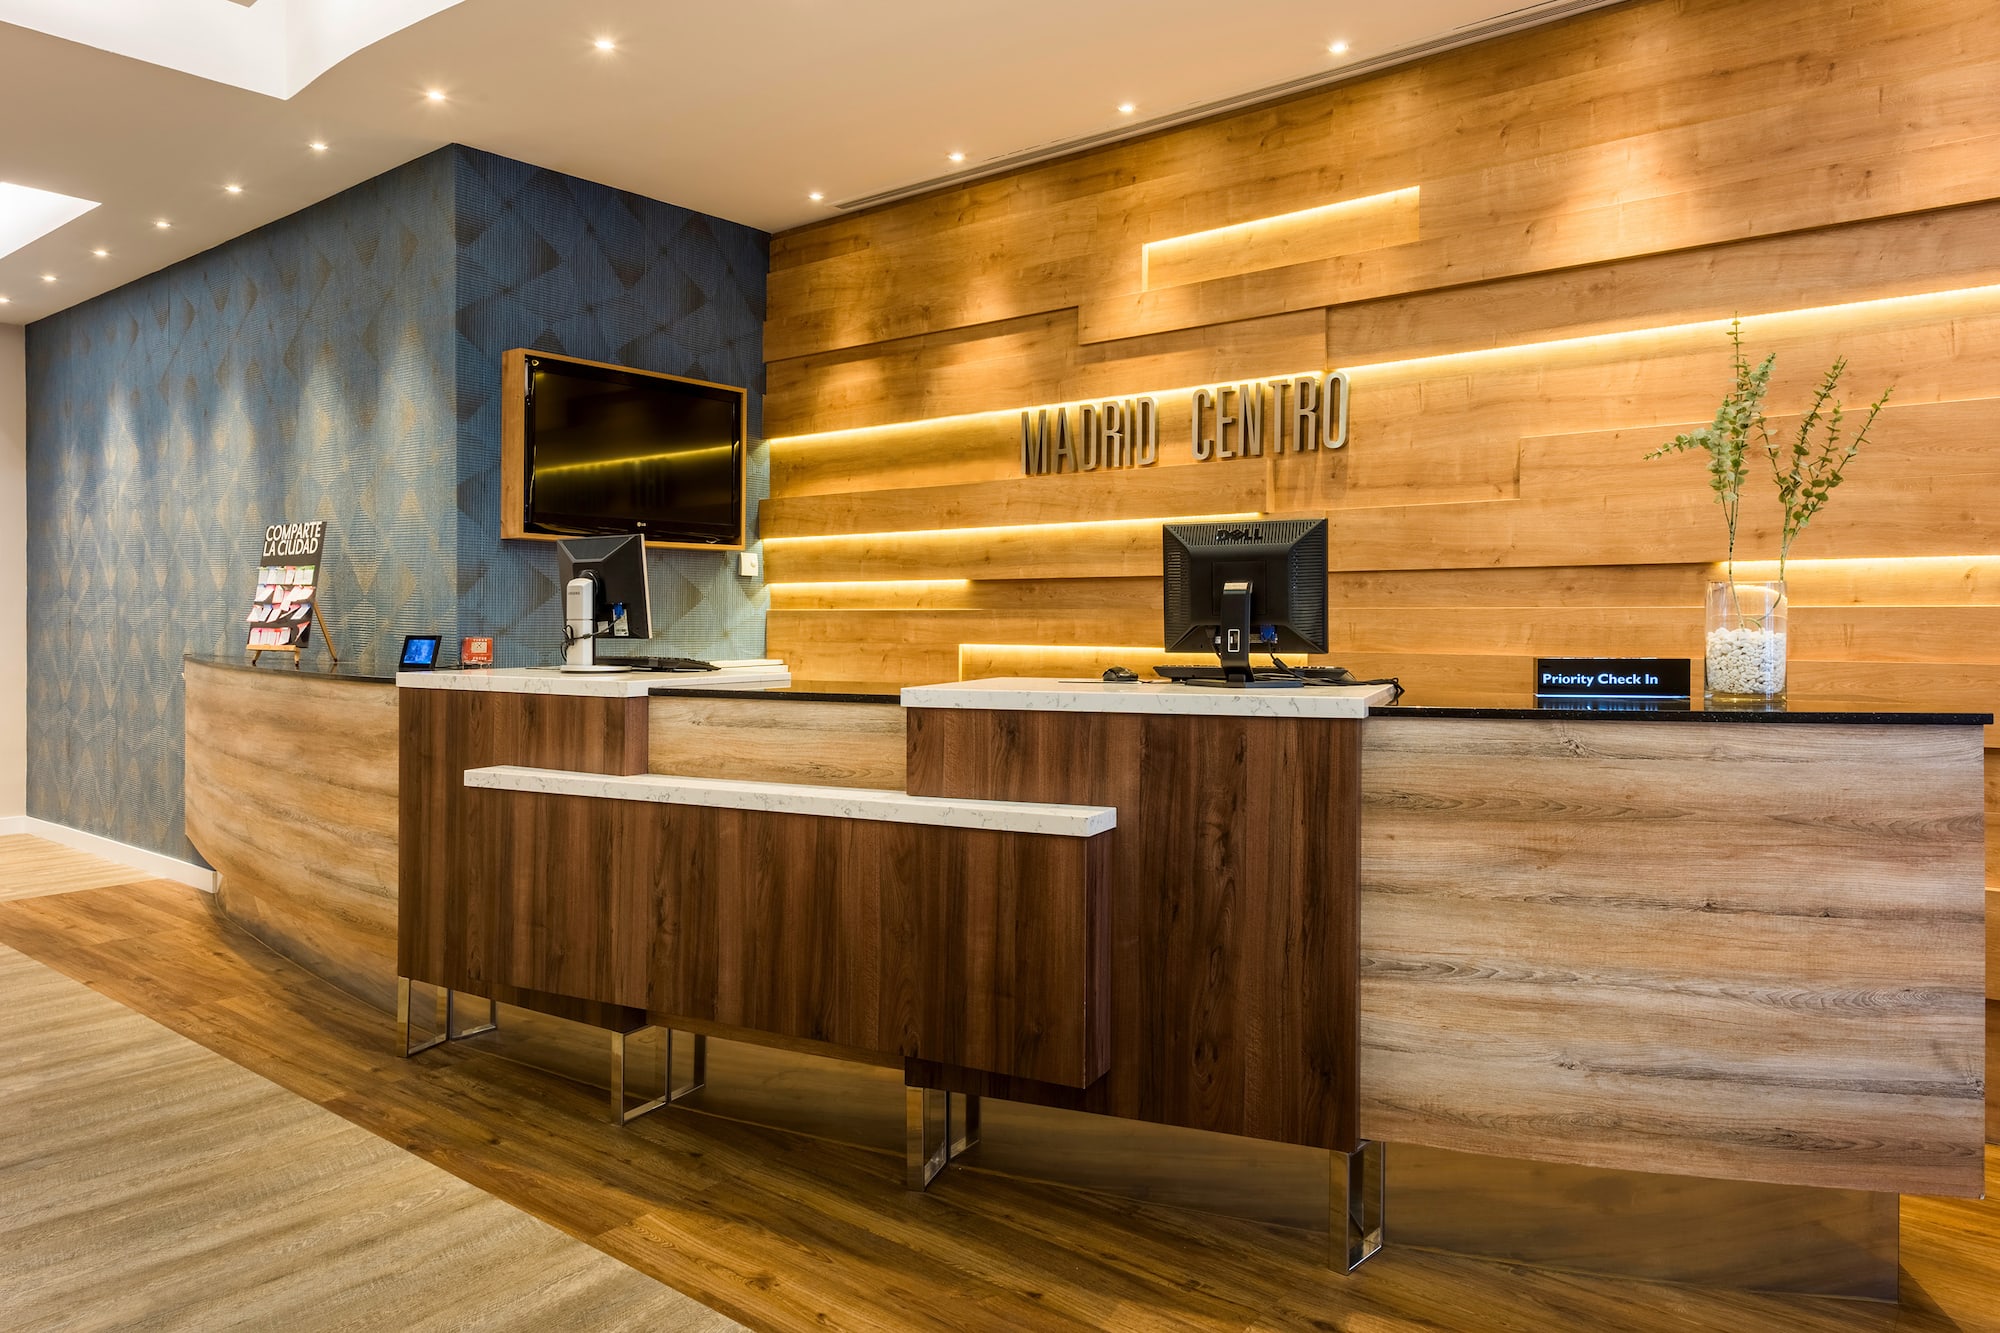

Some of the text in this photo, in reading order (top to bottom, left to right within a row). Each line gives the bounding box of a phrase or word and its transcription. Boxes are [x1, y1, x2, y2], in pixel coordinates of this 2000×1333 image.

[1021, 371, 1349, 475] MADRID CENTRO
[266, 521, 322, 541] COMPARTE
[1215, 528, 1263, 541] DELL
[263, 538, 318, 556] LA CIUDAD
[1542, 673, 1659, 687] Priority Check In
